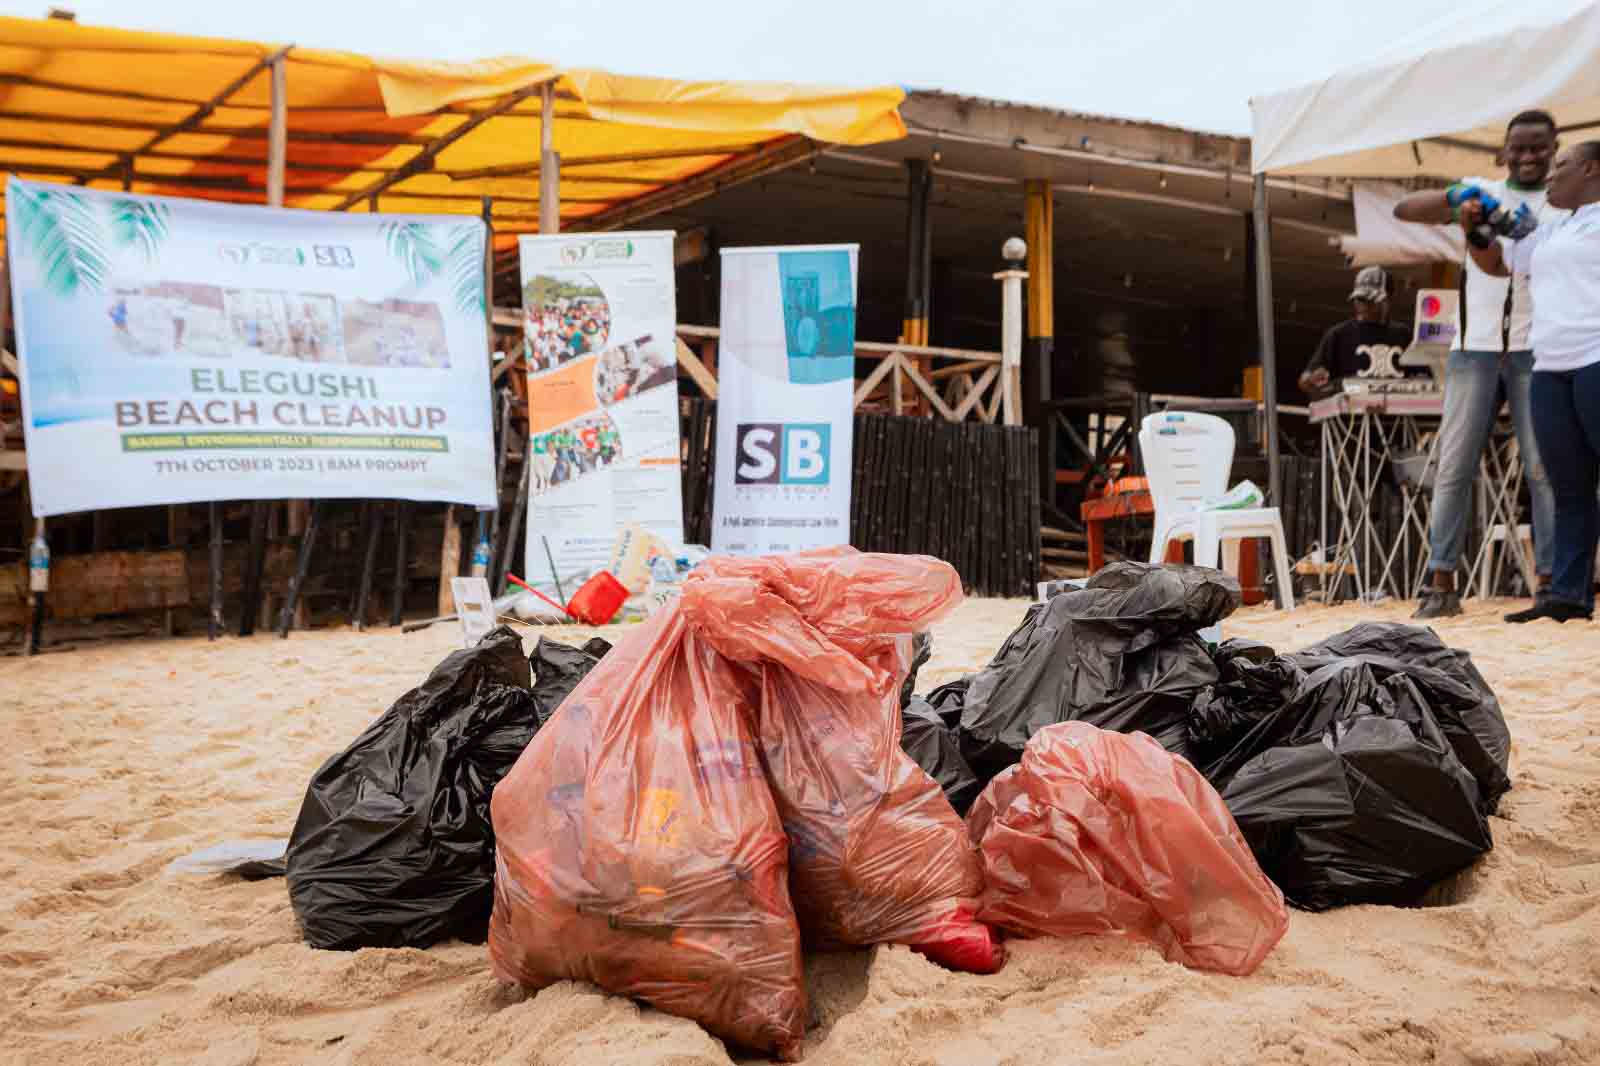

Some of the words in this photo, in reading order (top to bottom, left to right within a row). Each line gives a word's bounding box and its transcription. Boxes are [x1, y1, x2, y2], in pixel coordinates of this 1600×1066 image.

[191, 368, 377, 398] ELEGUSHI
[115, 400, 259, 427] BEACH
[272, 401, 447, 430] CLEANUP
[154, 458, 188, 473] 7TH
[193, 456, 273, 472] OCTOBER
[278, 456, 315, 472] 2023
[366, 457, 427, 473] PROMPT
[737, 427, 825, 480] SB
